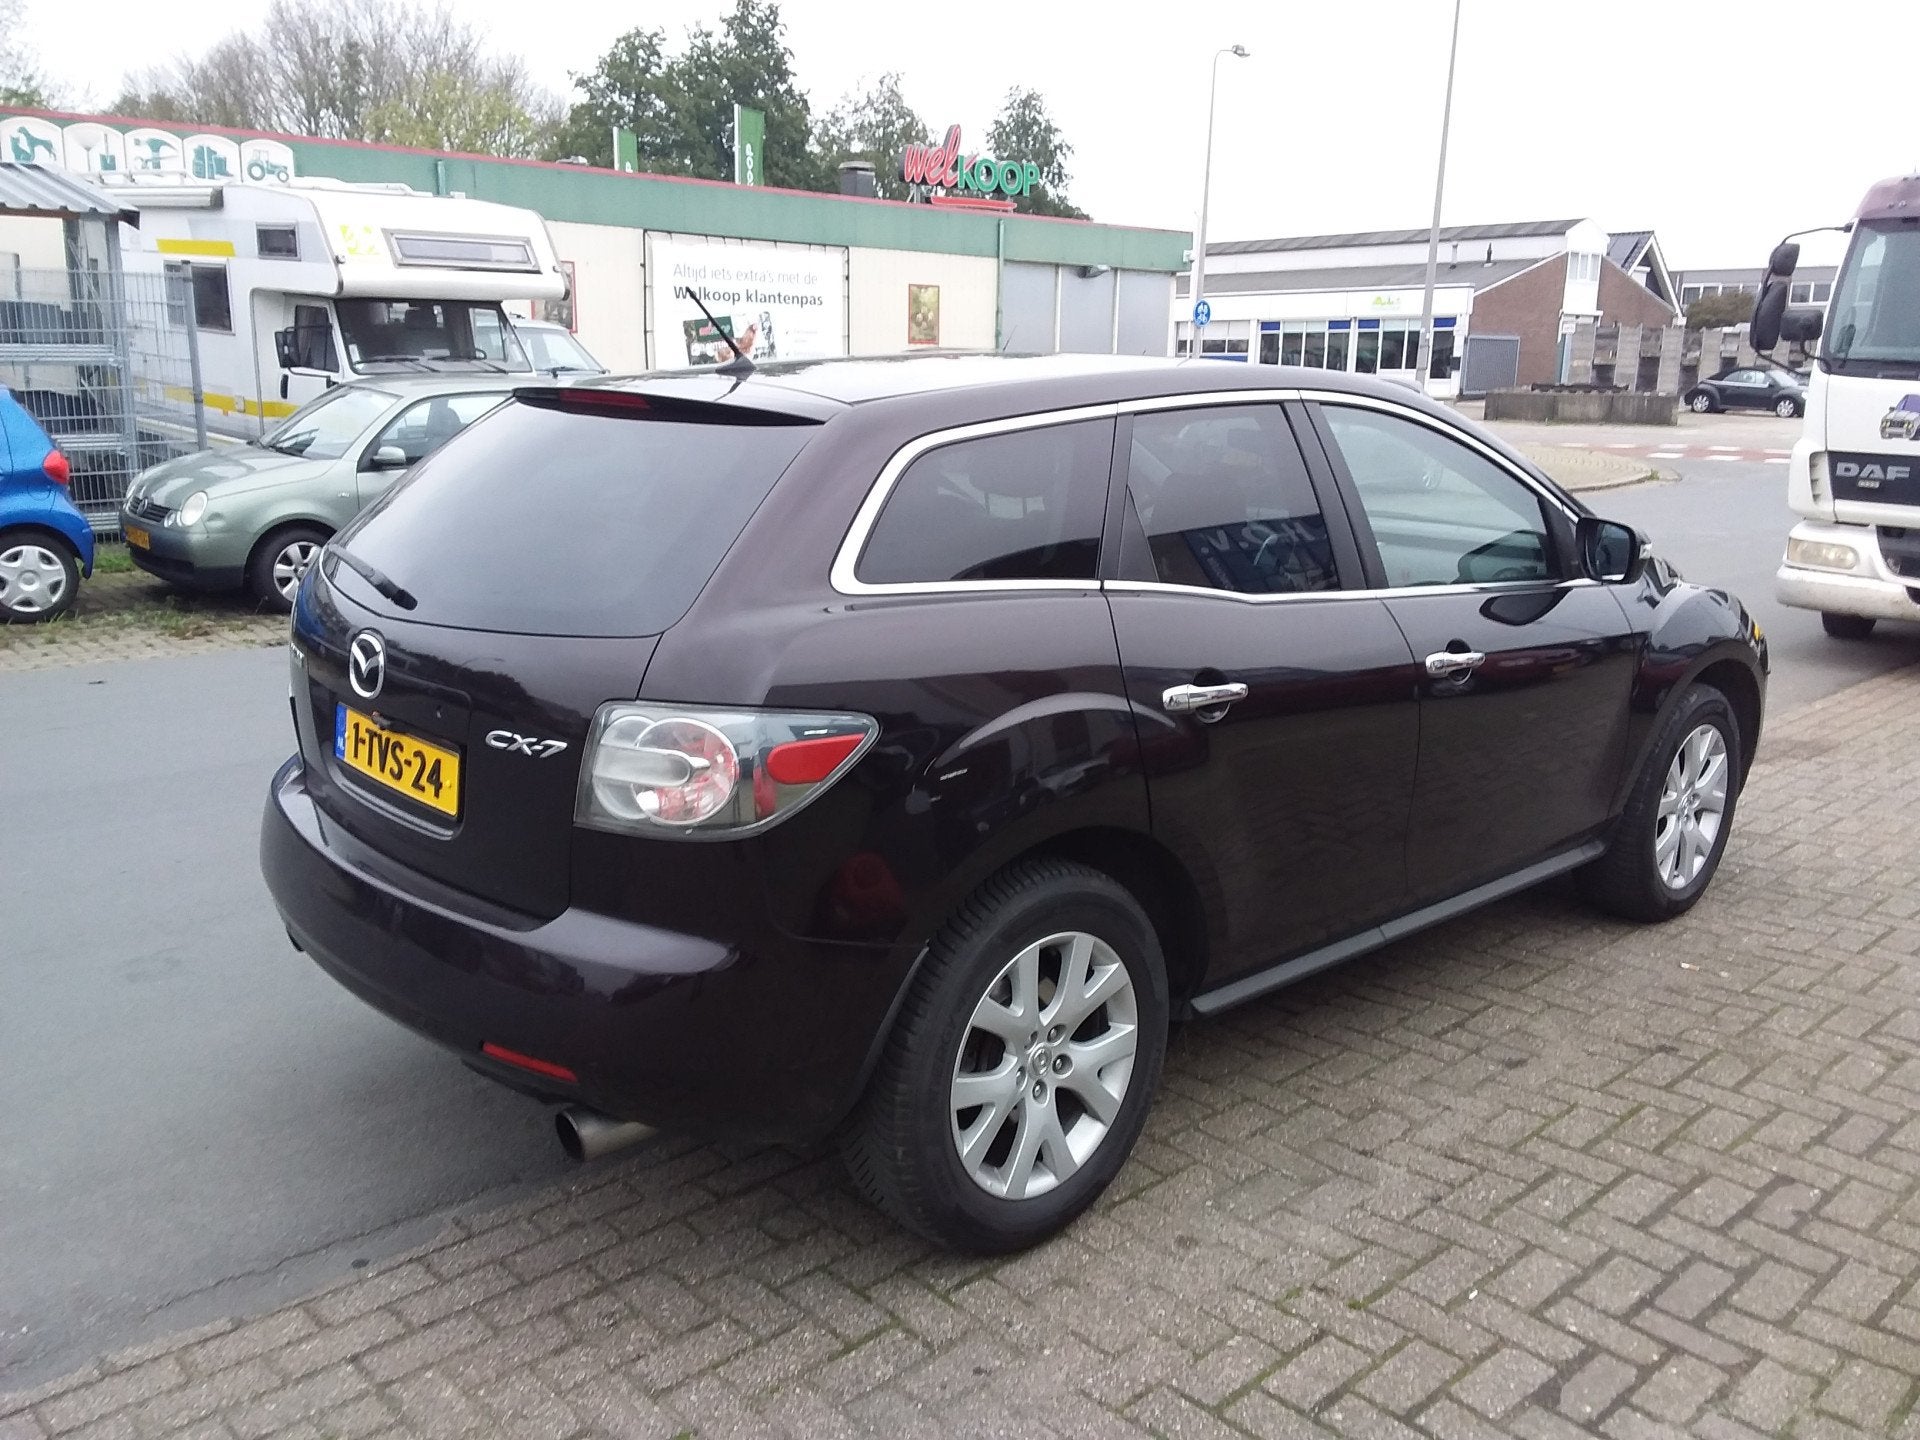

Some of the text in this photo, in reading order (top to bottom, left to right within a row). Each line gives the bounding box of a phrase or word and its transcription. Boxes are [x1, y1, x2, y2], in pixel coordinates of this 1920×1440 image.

[673, 263, 818, 285] Altijd iets extra's met de
[745, 288, 823, 308] klantenpas
[1835, 461, 1910, 480] DAF
[485, 730, 568, 758] CX-7
[353, 721, 443, 799] 1-TVS-24
